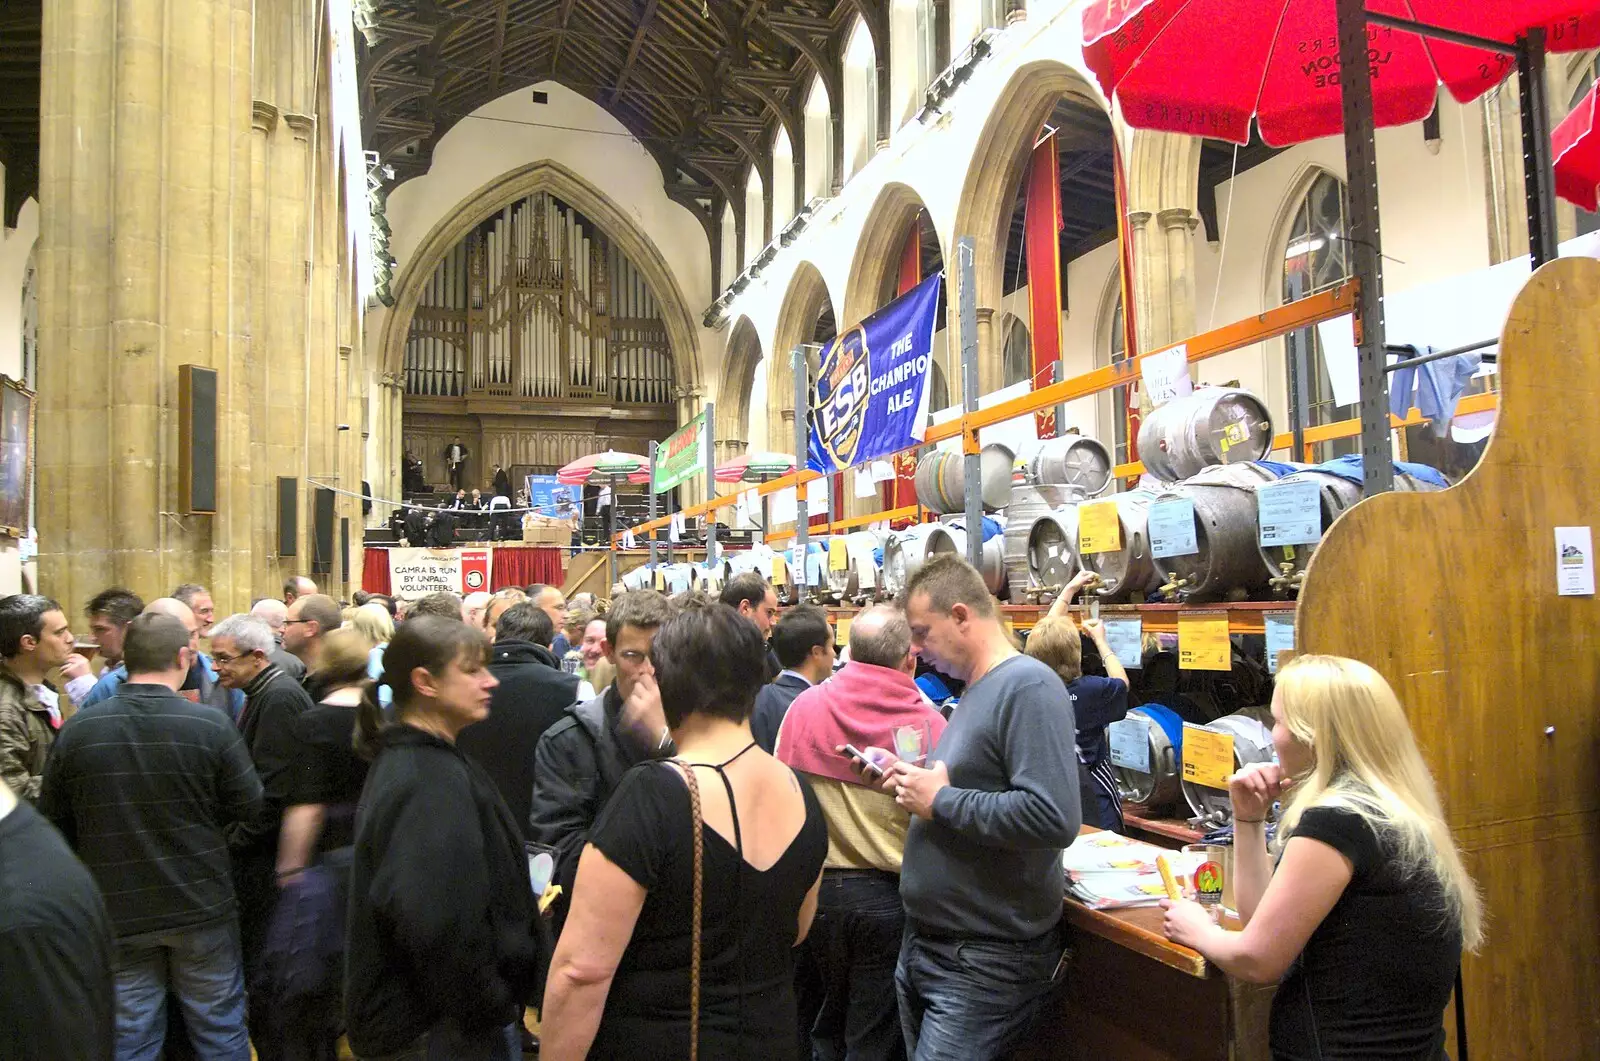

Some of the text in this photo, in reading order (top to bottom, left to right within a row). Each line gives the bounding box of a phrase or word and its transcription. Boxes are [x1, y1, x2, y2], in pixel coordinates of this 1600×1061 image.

[891, 331, 913, 360] THE
[870, 352, 932, 396] CHAMPIO
[822, 362, 867, 440] ESB
[887, 388, 914, 415] ALE
[395, 566, 457, 574] CAMRA IS RUN
[404, 575, 448, 583] BY UNPAID
[400, 584, 454, 592] VOLUNTEERS
